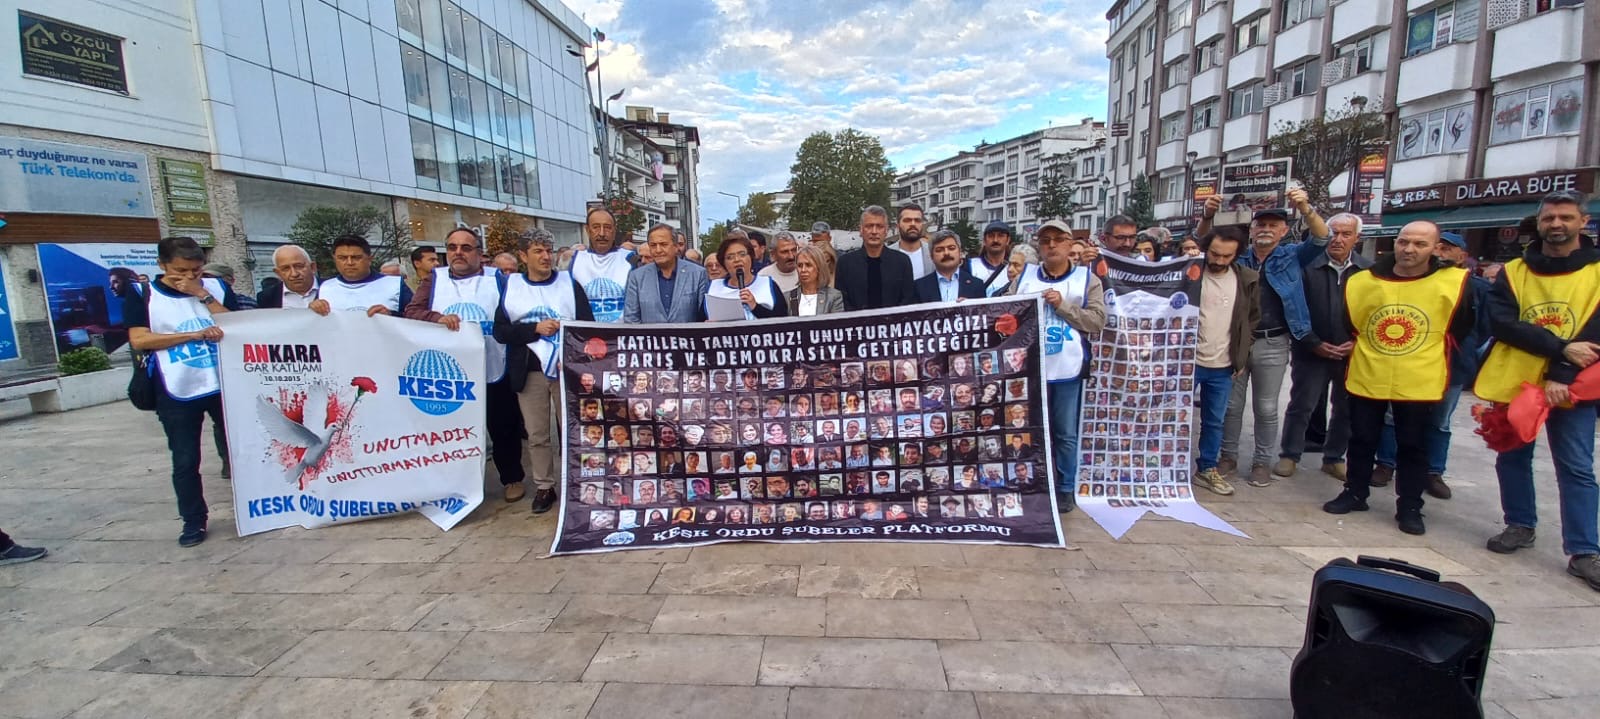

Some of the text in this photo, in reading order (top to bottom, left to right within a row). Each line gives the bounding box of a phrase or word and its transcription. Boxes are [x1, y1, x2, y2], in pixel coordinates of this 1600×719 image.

[60, 29, 115, 53] ÖZGÜL
[72, 46, 106, 62] YAPI
[17, 148, 89, 163] duyduğunuz
[92, 157, 105, 166] ne
[108, 159, 138, 169] varsa
[19, 162, 140, 183] Türk Telekom'da.
[1526, 173, 1577, 194] BÜFE
[702, 331, 802, 350] TANIYORUZ!
[810, 314, 988, 344] UNUTTURMAYACAĞIZ!
[243, 344, 322, 363] ANKARA
[617, 352, 674, 370] BARIŞ
[685, 352, 706, 367] VE
[244, 363, 269, 373] GAR
[398, 375, 477, 401] KESK
[424, 403, 448, 413] 1995
[363, 426, 478, 454] UNUTMADIK
[248, 494, 296, 518] KESK
[300, 494, 324, 517] ORDU
[329, 499, 398, 521] ŞUBELER
[652, 526, 709, 542] KESK
[716, 527, 776, 537] ORDU
[883, 523, 1012, 537] PLATFORMU
